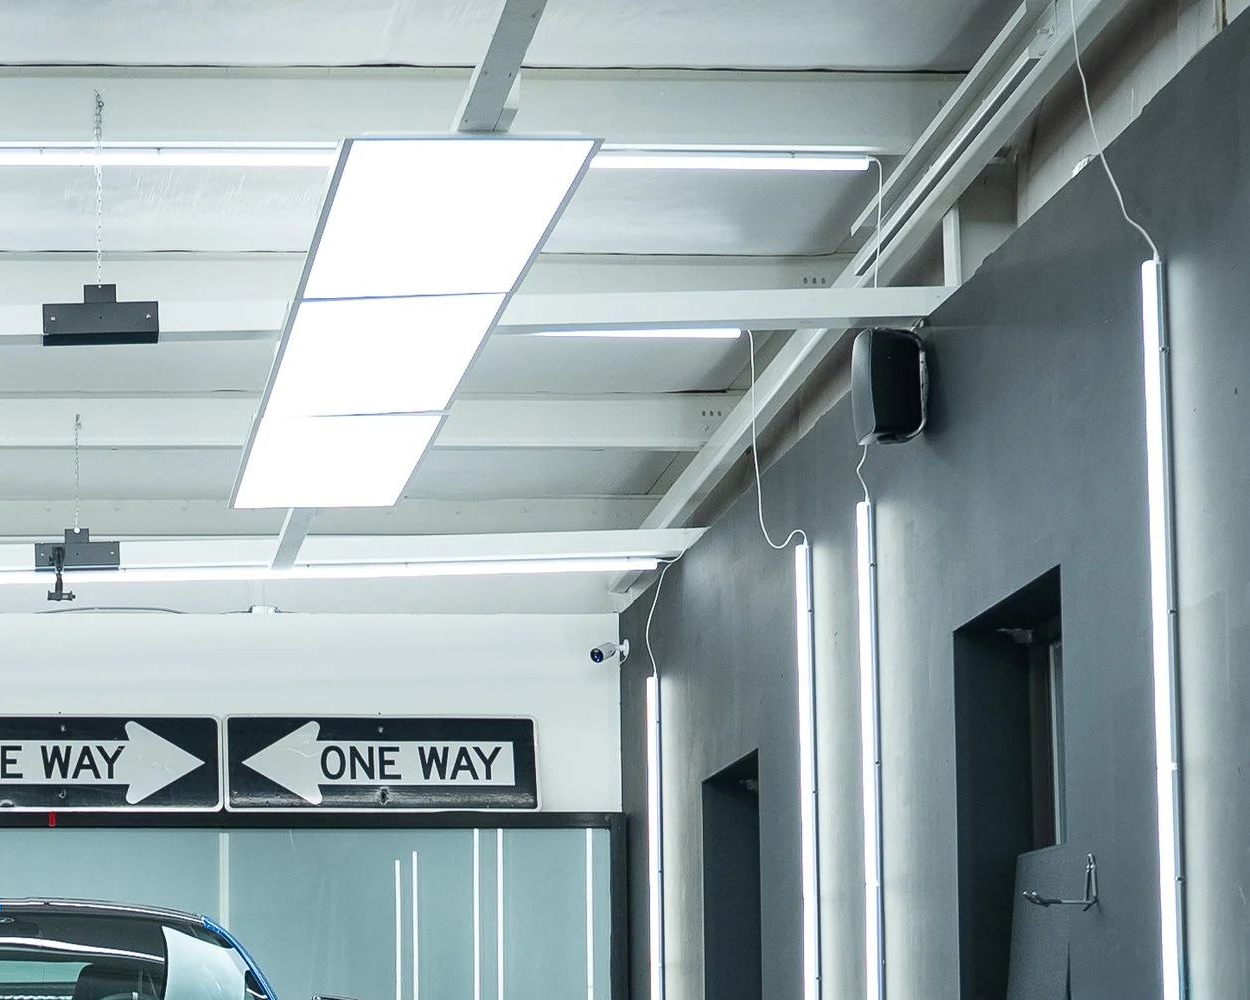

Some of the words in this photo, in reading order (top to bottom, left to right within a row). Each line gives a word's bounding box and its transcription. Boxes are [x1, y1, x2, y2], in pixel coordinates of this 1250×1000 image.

[40, 744, 126, 780] WAY
[320, 745, 402, 780] ONE
[417, 745, 502, 781] WAY
